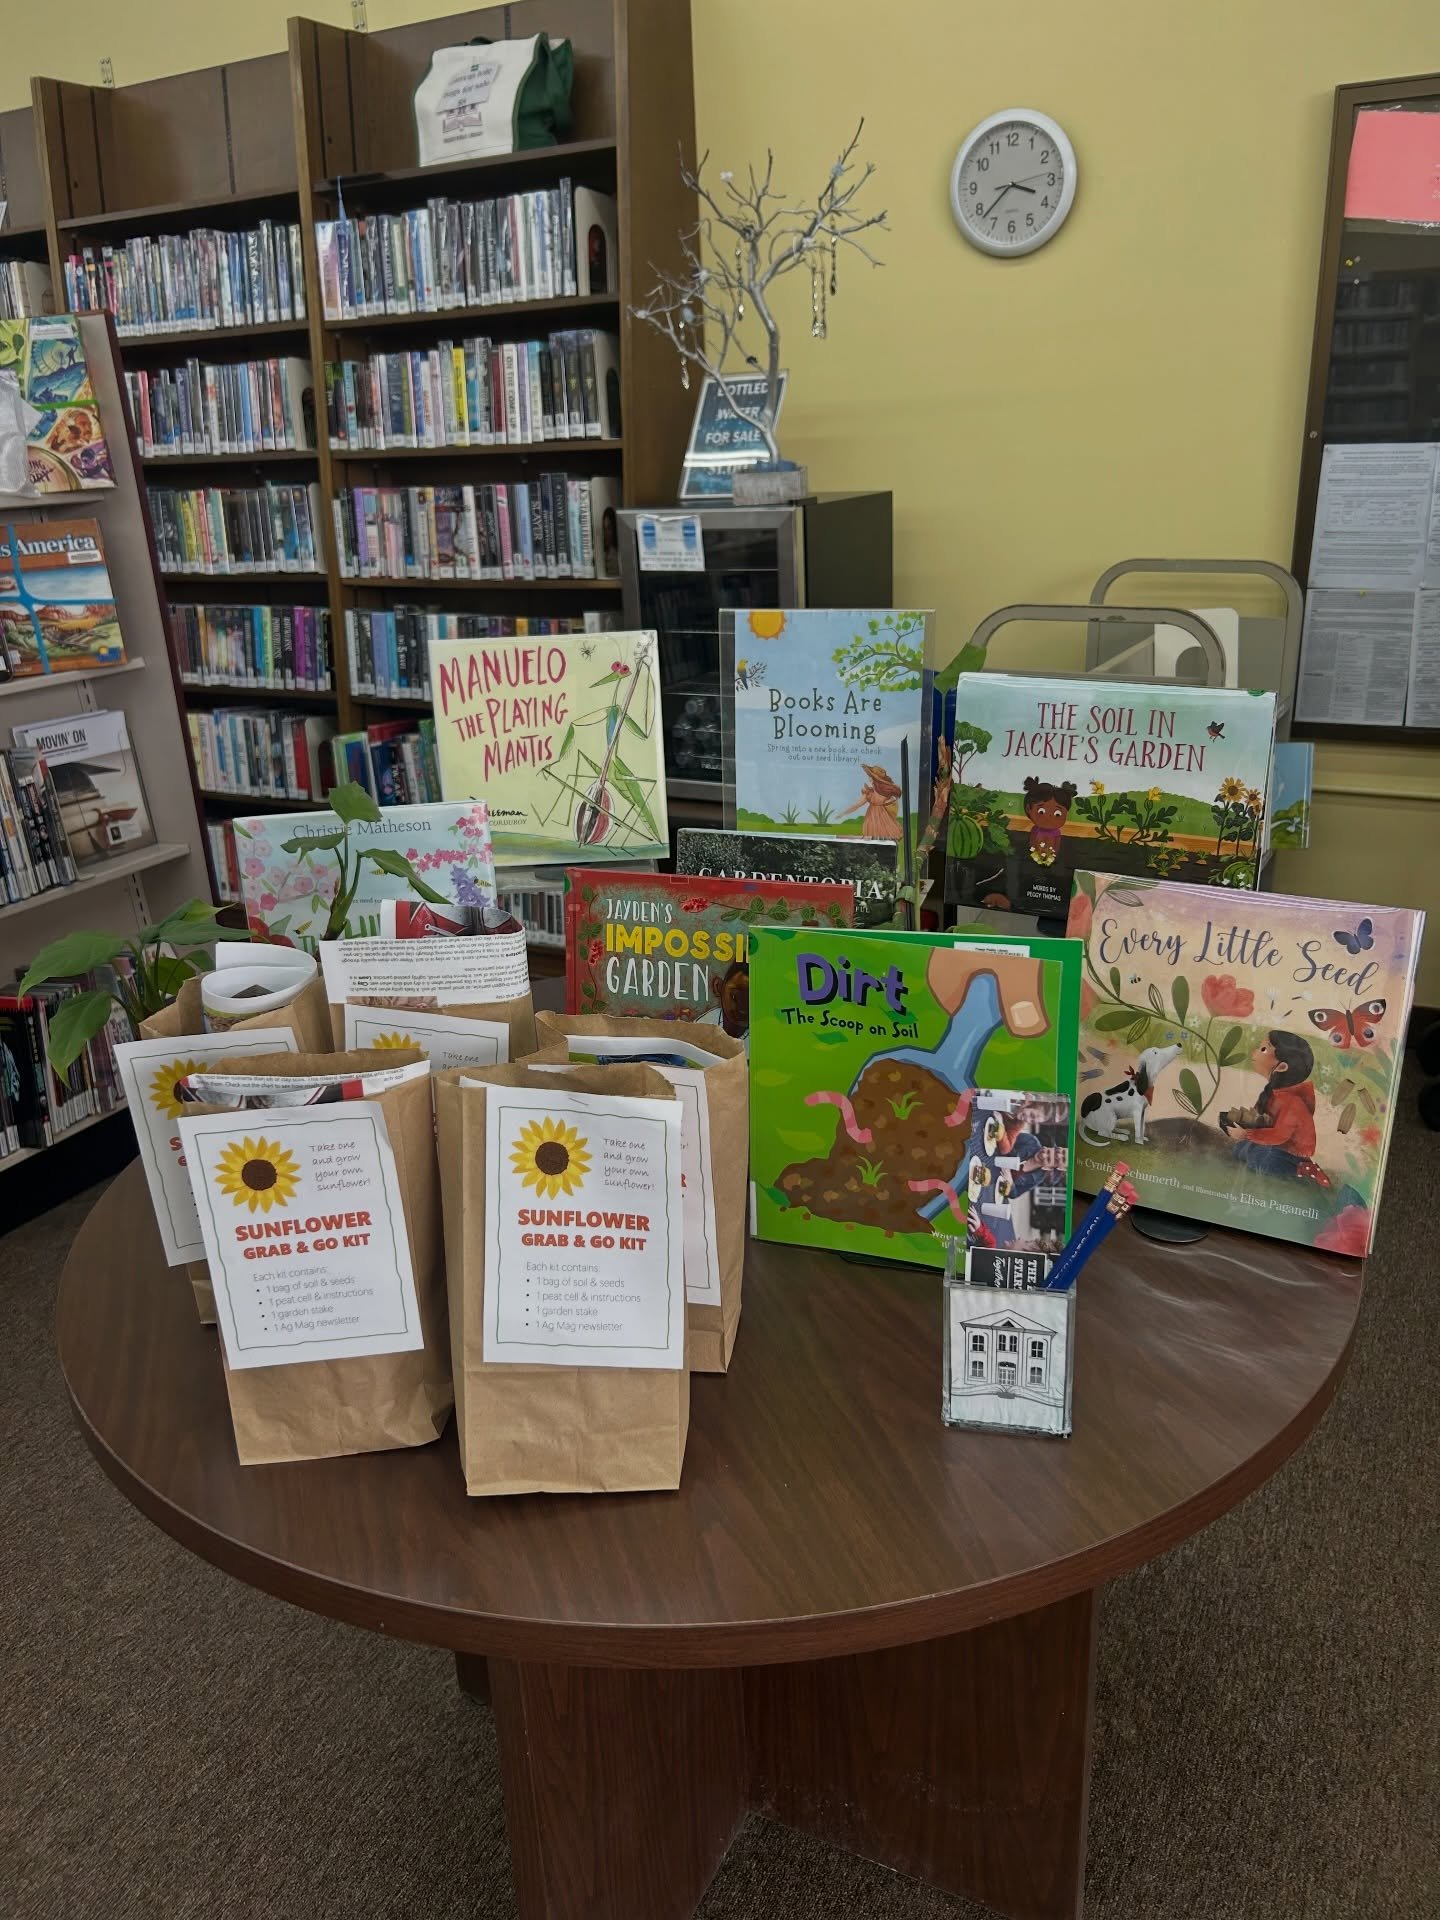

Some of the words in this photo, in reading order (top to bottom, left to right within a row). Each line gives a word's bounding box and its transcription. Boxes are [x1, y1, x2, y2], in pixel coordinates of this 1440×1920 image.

[1008, 133, 1019, 146] 12
[1030, 138, 1034, 149] 1
[990, 142, 999, 155] 11
[1041, 151, 1049, 163] 2
[977, 158, 989, 171] 10
[1048, 173, 1055, 186] 3
[970, 182, 977, 195] 9
[1041, 196, 1048, 208] 4
[976, 203, 983, 215] 8
[990, 217, 997, 230] 7
[1026, 214, 1034, 226] 5
[1008, 221, 1016, 233] 6
[506, 356, 514, 369] ON
[508, 390, 516, 414] COME
[510, 417, 517, 429] UP
[705, 432, 730, 444] FOR
[732, 431, 760, 442] SALE
[532, 500, 543, 541] SLAYER
[16, 536, 95, 554] America
[439, 646, 566, 716] MANUELO
[769, 688, 835, 712] Books
[843, 691, 882, 714] Are
[451, 712, 485, 742] THE
[486, 692, 569, 738] PLAYING
[1037, 702, 1080, 732] THE
[1087, 705, 1138, 737] SOIL
[1148, 709, 1176, 739] IN
[773, 714, 876, 744] Blooming
[36, 733, 70, 750] MOVIN'
[73, 729, 86, 743] ON
[768, 744, 790, 753] Spring
[1001, 729, 1100, 764] JACKIE'S
[1108, 737, 1206, 772] GARDEN
[483, 734, 553, 783] MANTIS
[357, 819, 432, 836] Matheson
[1032, 884, 1049, 893] WORDS
[1026, 891, 1041, 899] PEGGY
[1042, 893, 1062, 902] THOMAS
[605, 898, 673, 924] JAYDEN'S
[605, 923, 749, 964] IMPOSSI
[1100, 919, 1187, 965] Every
[1193, 921, 1283, 968] Little
[1293, 940, 1379, 995] Seed
[606, 956, 709, 1001] GARDEN
[796, 953, 908, 1017] Dirt
[781, 1008, 815, 1025] The
[820, 1009, 865, 1032] Scoop
[869, 1022, 887, 1036] on
[892, 1021, 920, 1039] Soil
[309, 1142, 336, 1151] Take
[338, 1141, 355, 1150] one
[604, 1138, 627, 1148] Take
[312, 1155, 333, 1165] and
[335, 1154, 361, 1165] grow
[604, 1152, 622, 1160] and
[625, 1155, 649, 1165] grow
[315, 1167, 339, 1182] your
[604, 1166, 627, 1177] your
[630, 1169, 649, 1177] own
[317, 1178, 371, 1191] sunflower!
[604, 1179, 655, 1191] sunflower!
[1240, 1193, 1267, 1209] Elisa
[1268, 1198, 1319, 1220] Paganelli
[235, 1211, 372, 1241] SUNFLOWER
[518, 1208, 650, 1232] SUNFLOWER
[243, 1243, 292, 1259] GRAB
[297, 1241, 310, 1254] &
[313, 1236, 339, 1251] GO
[343, 1233, 371, 1247] KIT
[521, 1233, 569, 1247] GRAB
[574, 1236, 585, 1248] &
[590, 1236, 614, 1249] GO
[619, 1237, 647, 1251] KIT
[526, 1261, 547, 1271] Each
[549, 1263, 560, 1271] kit
[561, 1263, 600, 1272] contains:
[993, 1256, 1006, 1288] Together
[1028, 1260, 1037, 1283] THE
[253, 1272, 275, 1282] Each
[276, 1270, 287, 1279] kit
[537, 1277, 541, 1286] 1
[543, 1277, 559, 1287] bag
[562, 1277, 571, 1286] of
[573, 1279, 588, 1287] soil
[589, 1279, 598, 1287] &
[600, 1279, 625, 1288] seeds
[273, 1283, 291, 1295] bag
[292, 1281, 301, 1291] of
[303, 1278, 320, 1288] soil
[321, 1277, 328, 1286] &
[330, 1275, 355, 1285] seeds
[275, 1295, 296, 1307] peat
[298, 1292, 313, 1304] cell
[314, 1292, 322, 1300] &
[323, 1287, 374, 1300] instructions
[536, 1292, 540, 1300] 1
[542, 1293, 562, 1303] peat
[564, 1293, 579, 1301] cell
[591, 1293, 641, 1303] instructions
[278, 1308, 309, 1321] garden
[311, 1304, 334, 1315] stake
[536, 1307, 540, 1315] 1
[542, 1308, 573, 1318] garden
[576, 1307, 598, 1316] stake
[281, 1322, 293, 1333] Ag
[297, 1320, 315, 1331] Mag
[316, 1315, 360, 1328] newsletter
[536, 1321, 540, 1329] 1
[542, 1322, 554, 1332] Ag
[557, 1322, 576, 1332] Mag
[578, 1322, 624, 1332] newsletter
